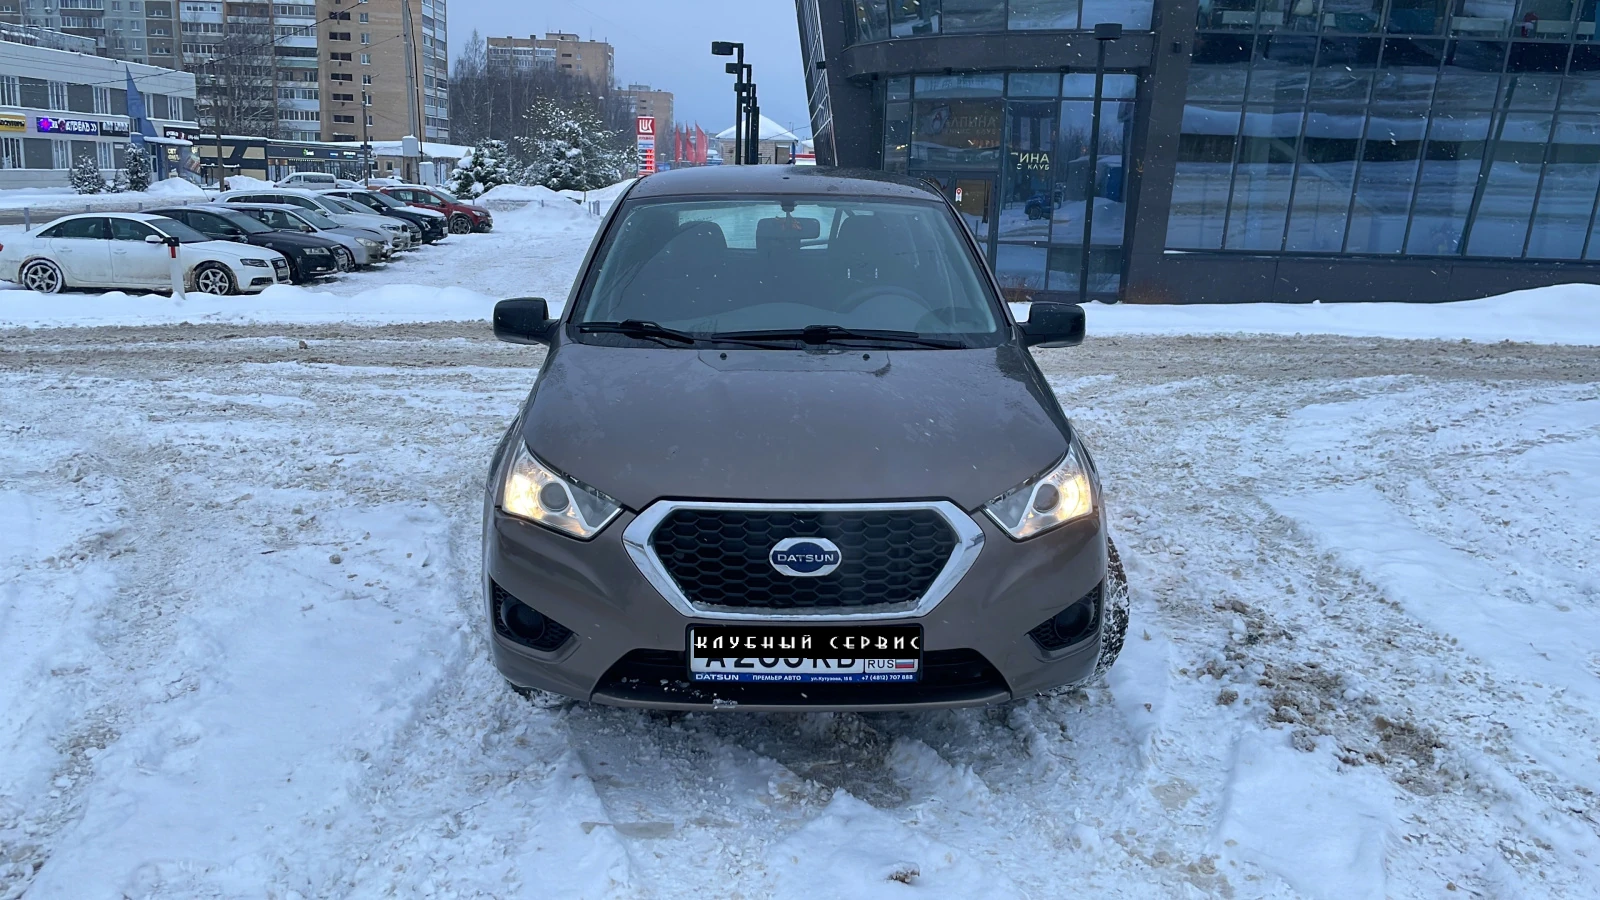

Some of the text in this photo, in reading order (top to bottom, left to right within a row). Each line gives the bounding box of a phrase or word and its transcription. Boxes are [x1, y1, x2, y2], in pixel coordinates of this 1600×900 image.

[777, 553, 834, 562] DATSUN
[867, 659, 895, 668] RUS
[695, 673, 739, 681] DATSUN
